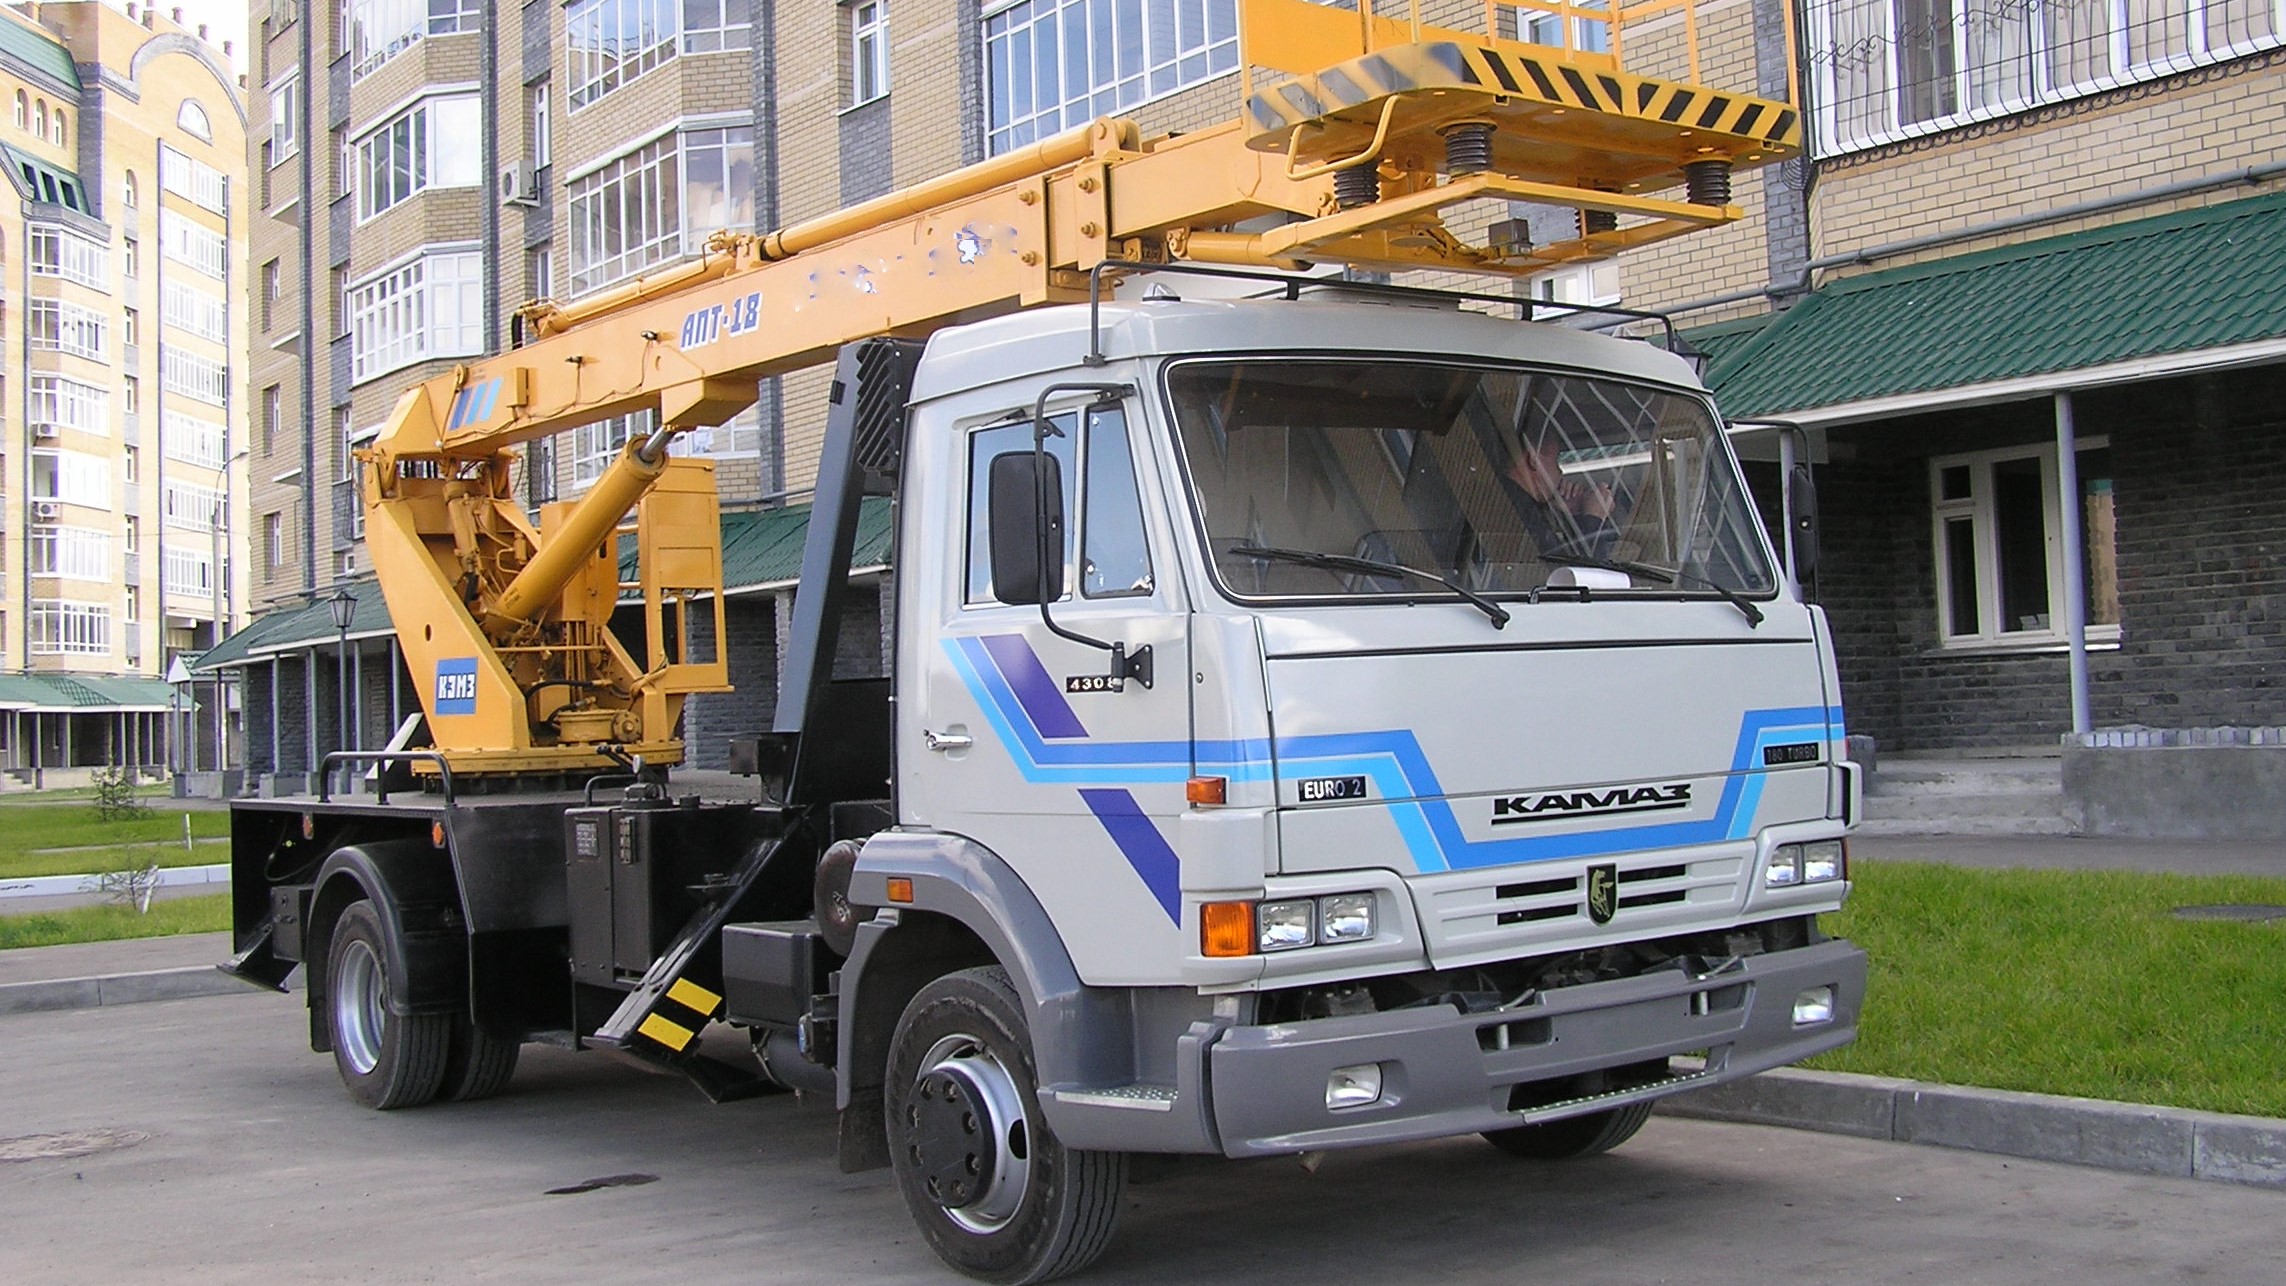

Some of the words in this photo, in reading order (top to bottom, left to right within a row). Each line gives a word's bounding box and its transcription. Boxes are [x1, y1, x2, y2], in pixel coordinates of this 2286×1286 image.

[438, 674, 475, 699] КЭМЗ
[1788, 745, 1816, 760] TURBO
[1304, 780, 1345, 799] EURO
[1352, 779, 1361, 795] 2
[1494, 784, 1691, 815] КАМАЗ
